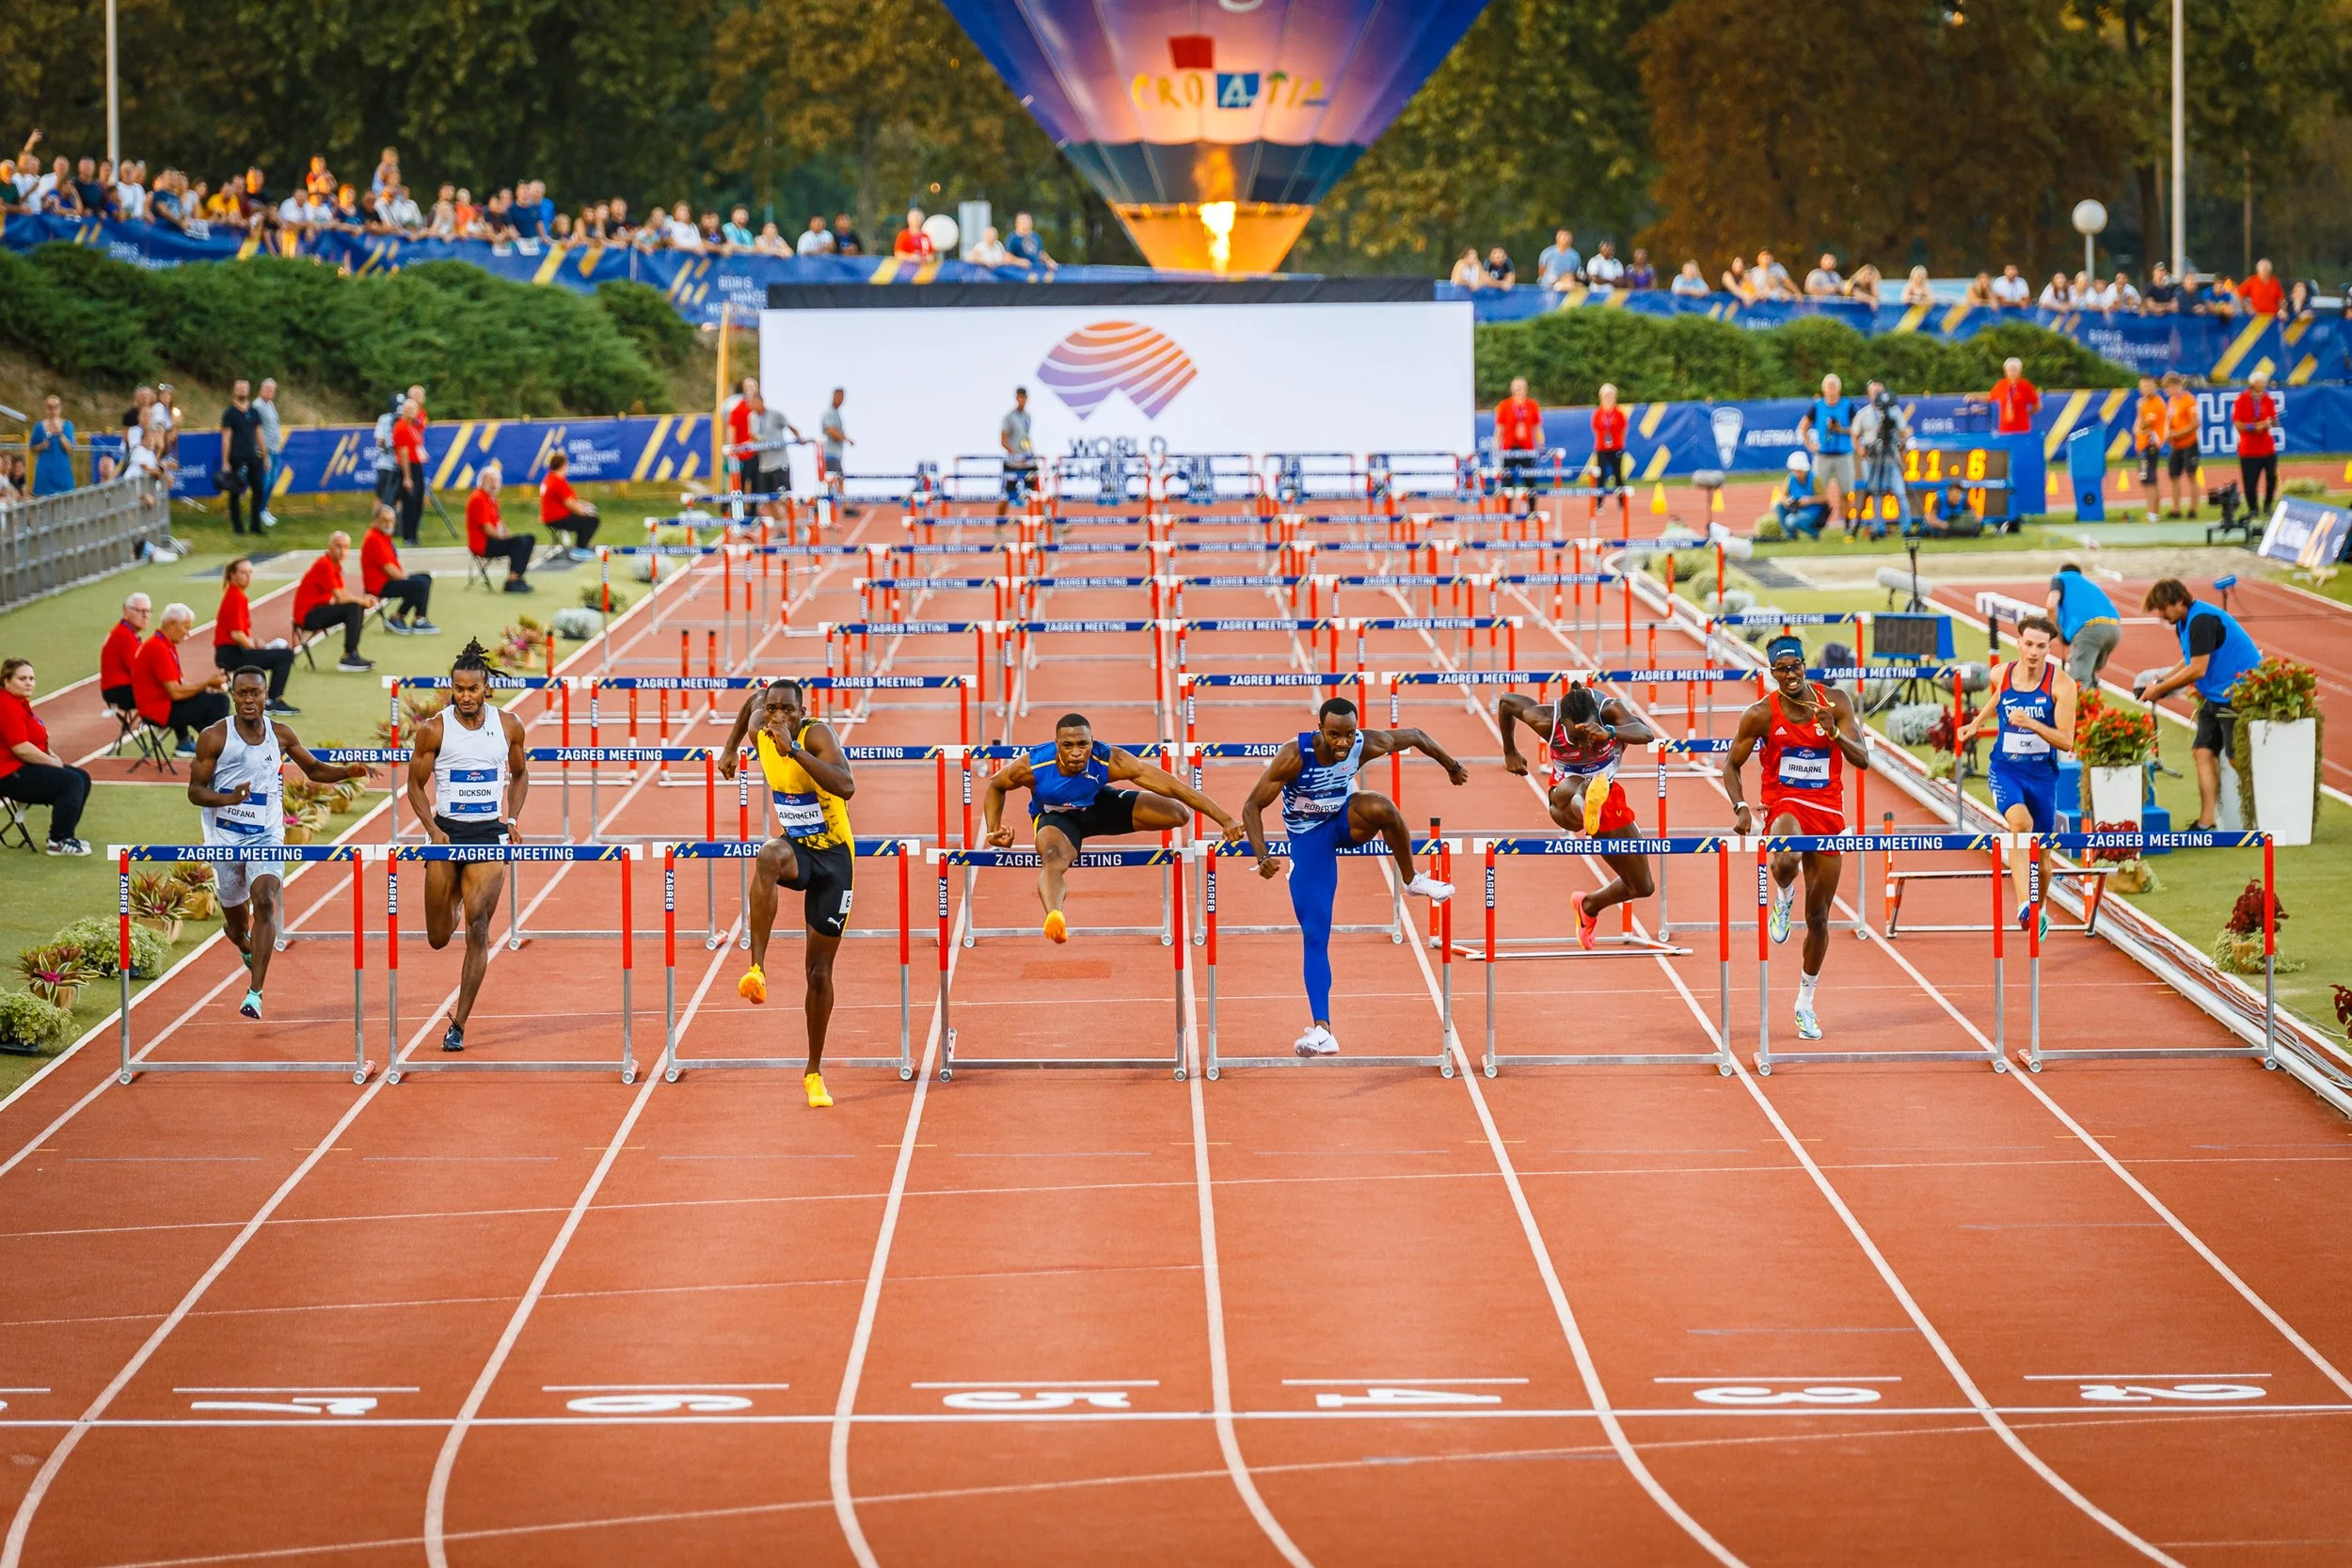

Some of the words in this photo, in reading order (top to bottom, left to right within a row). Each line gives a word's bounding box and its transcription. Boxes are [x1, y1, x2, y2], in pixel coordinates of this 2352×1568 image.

[1132, 71, 1329, 110] CROATIA
[1069, 436, 1167, 457] WORLD
[1216, 621, 1254, 631] ZAGREB
[1256, 620, 1299, 630] MEETING
[1393, 619, 1432, 629] ZAGREB
[1434, 619, 1476, 629] MEETING
[1742, 615, 1781, 625] ZAGREB
[1783, 614, 1825, 624] MEETING
[866, 623, 904, 633] ZAGREB
[906, 623, 949, 633] MEETING
[1043, 622, 1082, 632] ZAGREB
[1084, 622, 1127, 632] MEETING
[1437, 673, 1479, 685] ZAGREB
[1482, 673, 1530, 684] MEETING
[1630, 671, 1674, 681] ZAGREB
[1677, 670, 1724, 681] MEETING
[1823, 668, 1867, 679] ZAGREB
[1869, 667, 1917, 678] MEETING
[489, 677, 527, 689] EETING
[635, 677, 677, 689] ZAGREB
[681, 677, 728, 689] MEETING
[831, 677, 874, 688] ZAGREB
[877, 676, 924, 688] MEETING
[1230, 674, 1272, 686] ZAGREB
[1275, 674, 1323, 686] MEETING
[1244, 745, 1281, 756] ZAGR
[2020, 740, 2032, 749] CIK
[329, 750, 377, 762] ZAGREB
[382, 750, 413, 762] MEET
[556, 749, 605, 761] ZAGREB
[609, 749, 663, 761] MEETING
[850, 747, 904, 759] MEETING
[1788, 763, 1822, 774] IRIBARNE
[227, 807, 256, 818] FOFANA
[778, 810, 819, 820] ARCHMENT
[1816, 837, 1874, 850] ZAGREB
[1879, 836, 1943, 850] MEETING
[2087, 833, 2144, 847] ZAGREB
[2149, 832, 2213, 847] MEETING
[723, 843, 760, 857] ZAGR
[1544, 840, 1602, 853] ZAGREB
[1608, 839, 1671, 853] MEETING
[177, 847, 234, 861] ZAGREB
[239, 847, 303, 861] MEETING
[448, 847, 505, 861] ZAGREB
[510, 847, 574, 861] MEETING
[995, 853, 1042, 867] ZAGRE
[2030, 863, 2039, 901] ZAGREB
[119, 874, 128, 913] ZAGREB
[939, 879, 947, 916] ZAGREB
[1207, 873, 1216, 911] ZAGREB
[845, 895, 851, 908] 6
[1315, 1387, 1502, 1407] 4
[1693, 1386, 1881, 1404] 3
[2079, 1384, 2266, 1402] 2
[191, 1397, 377, 1415] 7
[566, 1394, 753, 1413] 6
[943, 1391, 1130, 1410] 5
